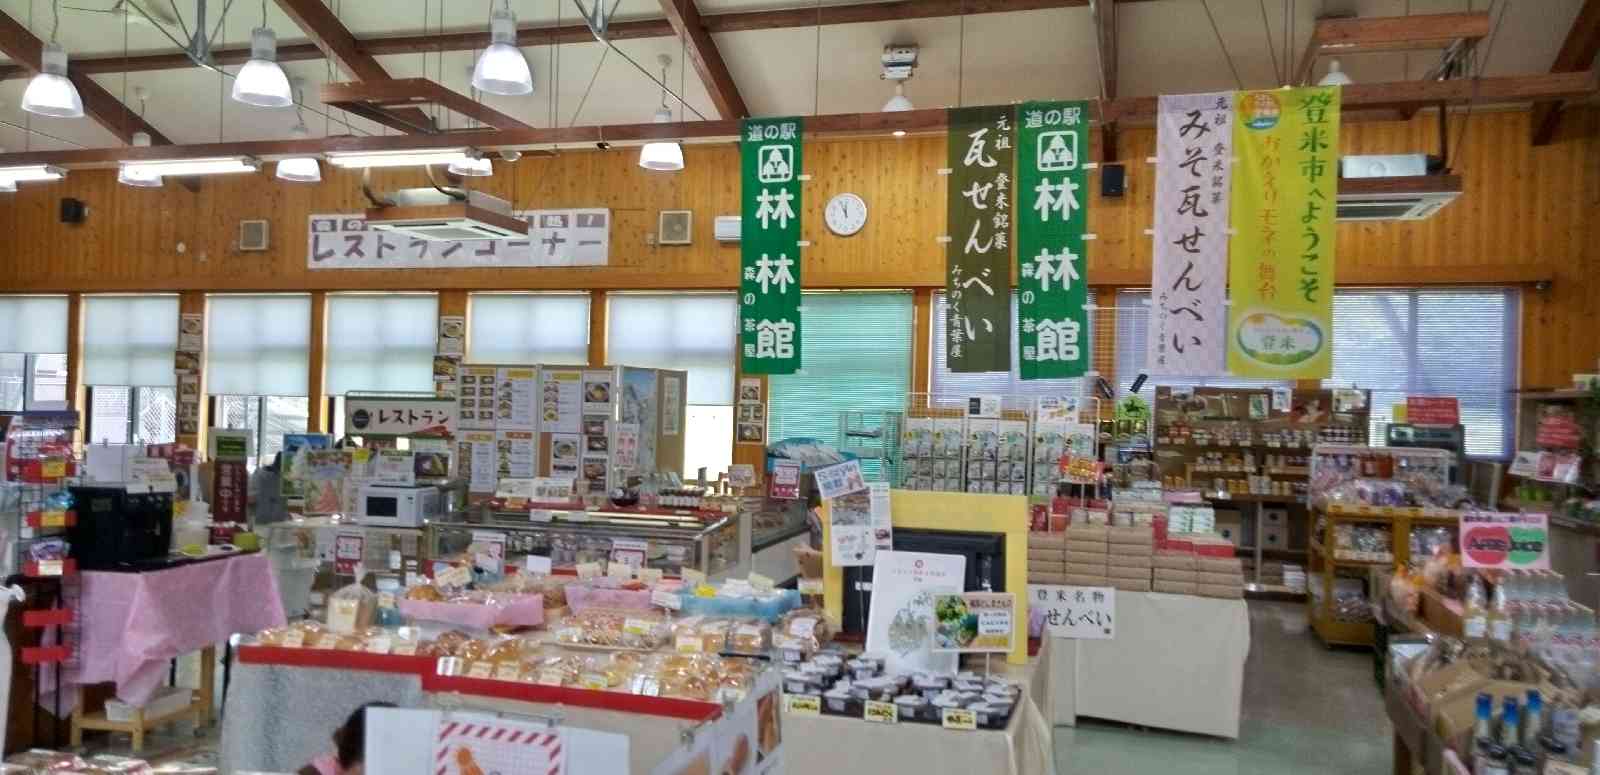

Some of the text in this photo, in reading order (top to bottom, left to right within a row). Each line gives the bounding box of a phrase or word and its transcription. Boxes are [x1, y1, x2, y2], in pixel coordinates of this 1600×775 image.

[747, 123, 796, 141] 道の駅
[993, 113, 1011, 150] 元祖
[1025, 107, 1081, 128] 道の駅
[1297, 91, 1332, 303] 登米市へようこそ
[312, 232, 602, 261] レストランコーナー
[962, 127, 998, 341] 瓦せんべい
[1170, 109, 1211, 354] みそ瓦せんべい
[755, 188, 796, 358] 林林館
[1033, 177, 1081, 361] 林林館
[1021, 262, 1036, 360] 森の茶屋
[378, 409, 449, 425] レストラン
[1047, 608, 1112, 626] せんべい
